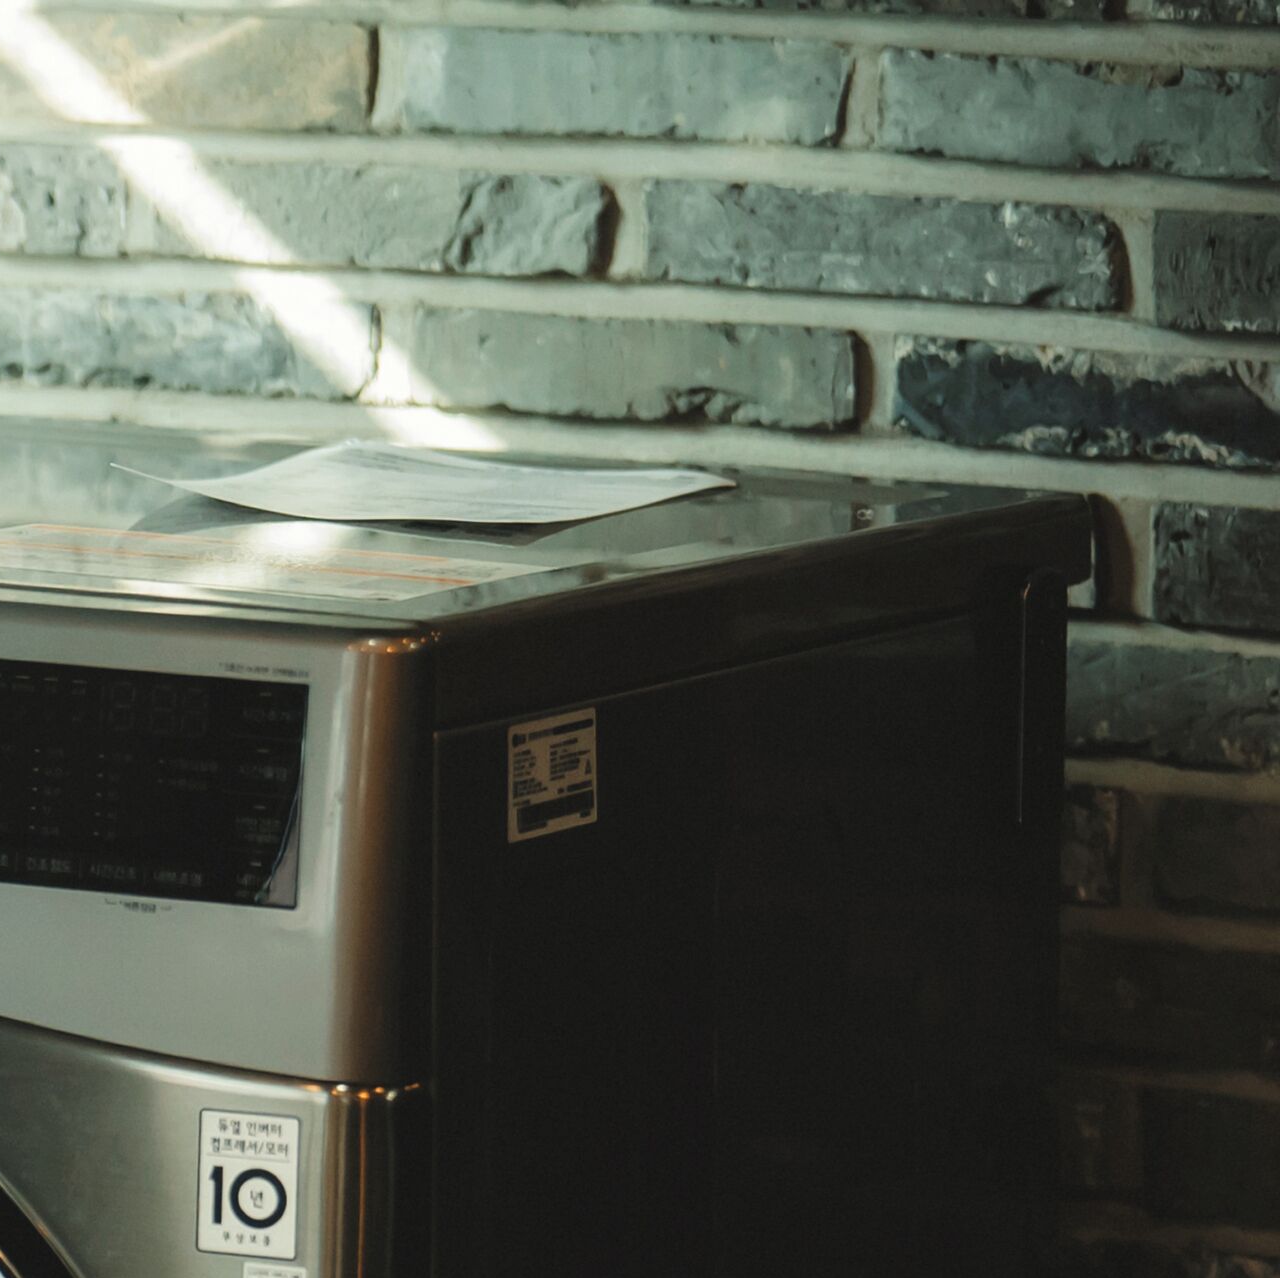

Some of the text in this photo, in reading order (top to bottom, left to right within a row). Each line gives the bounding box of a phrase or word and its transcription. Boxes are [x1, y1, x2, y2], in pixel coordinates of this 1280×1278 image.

[246, 1122, 282, 1138] 인버터
[209, 1166, 287, 1229] 10
[250, 1191, 263, 1208] 년
